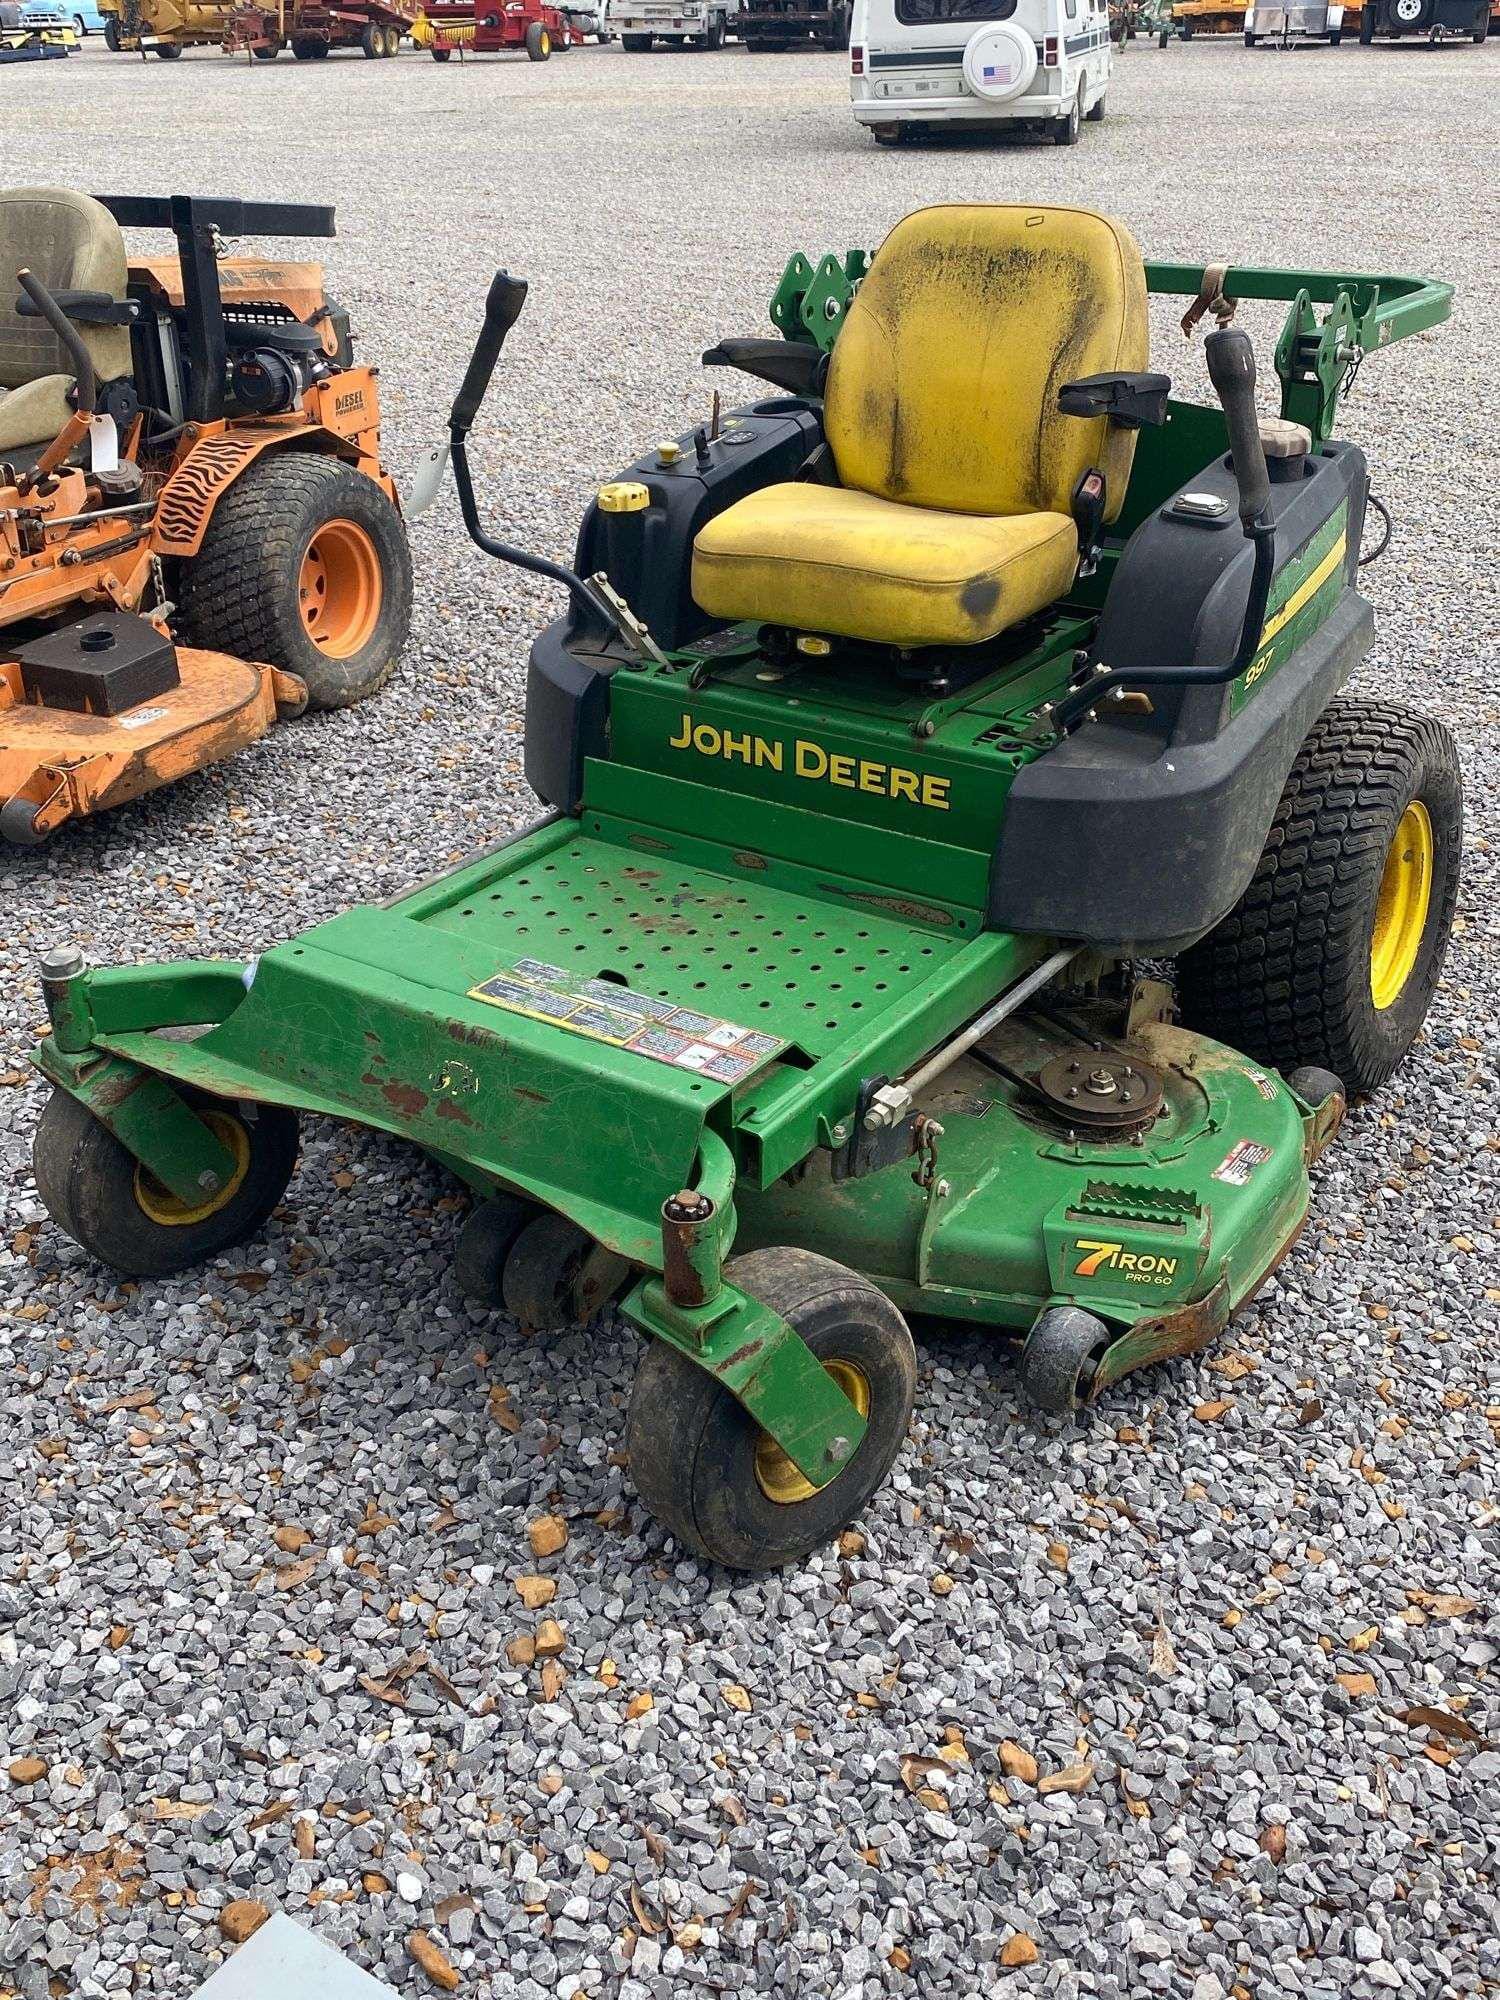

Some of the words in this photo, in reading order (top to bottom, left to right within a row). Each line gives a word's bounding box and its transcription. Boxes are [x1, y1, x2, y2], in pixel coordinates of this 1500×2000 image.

[335, 390, 362, 410] DIESEL
[1244, 647, 1275, 691] 997
[669, 714, 783, 772] JOHN
[795, 739, 951, 811] DEERE
[1125, 1272, 1152, 1283] PRO
[1154, 1276, 1173, 1285] 60
